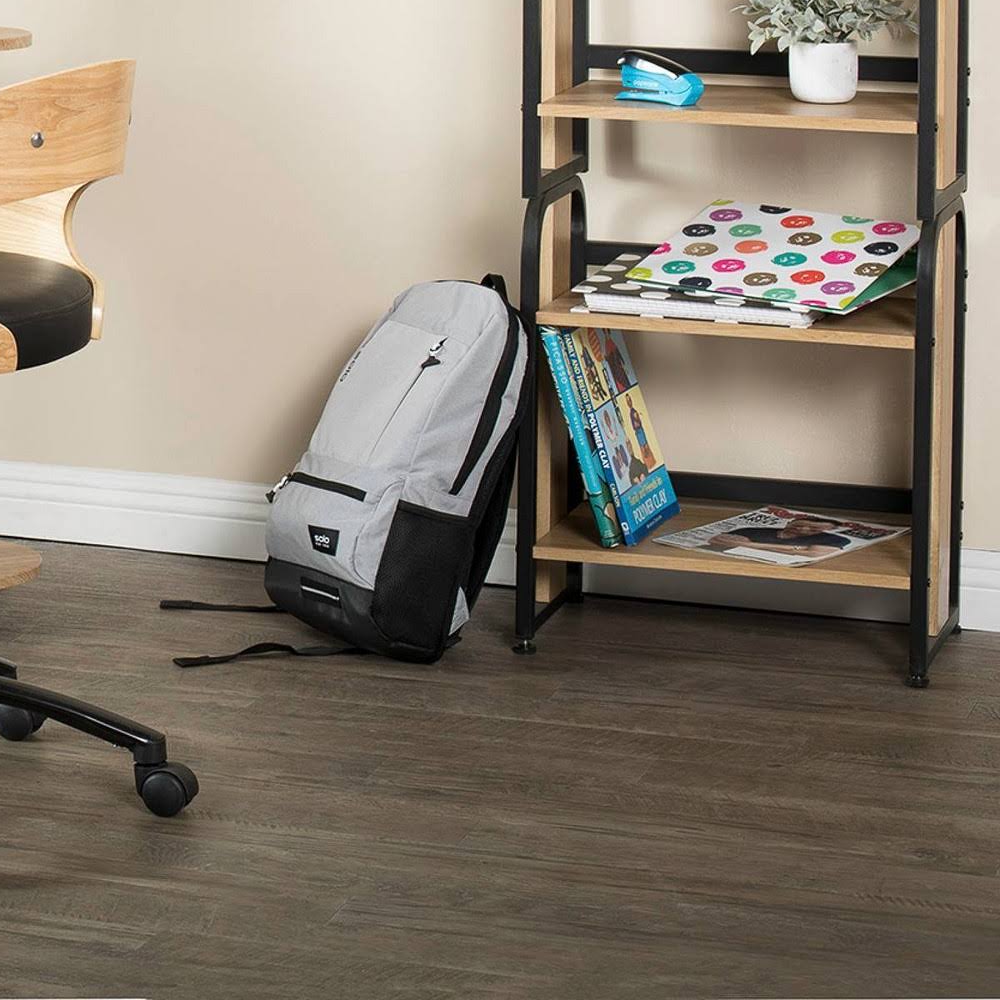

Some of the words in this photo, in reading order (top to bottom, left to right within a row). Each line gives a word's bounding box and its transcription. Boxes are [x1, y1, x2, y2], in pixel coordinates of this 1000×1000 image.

[551, 341, 568, 385] PICASSO
[572, 359, 581, 375] AND
[587, 411, 604, 449] POLYMER
[599, 450, 611, 469] CLAY
[314, 534, 330, 544] solo
